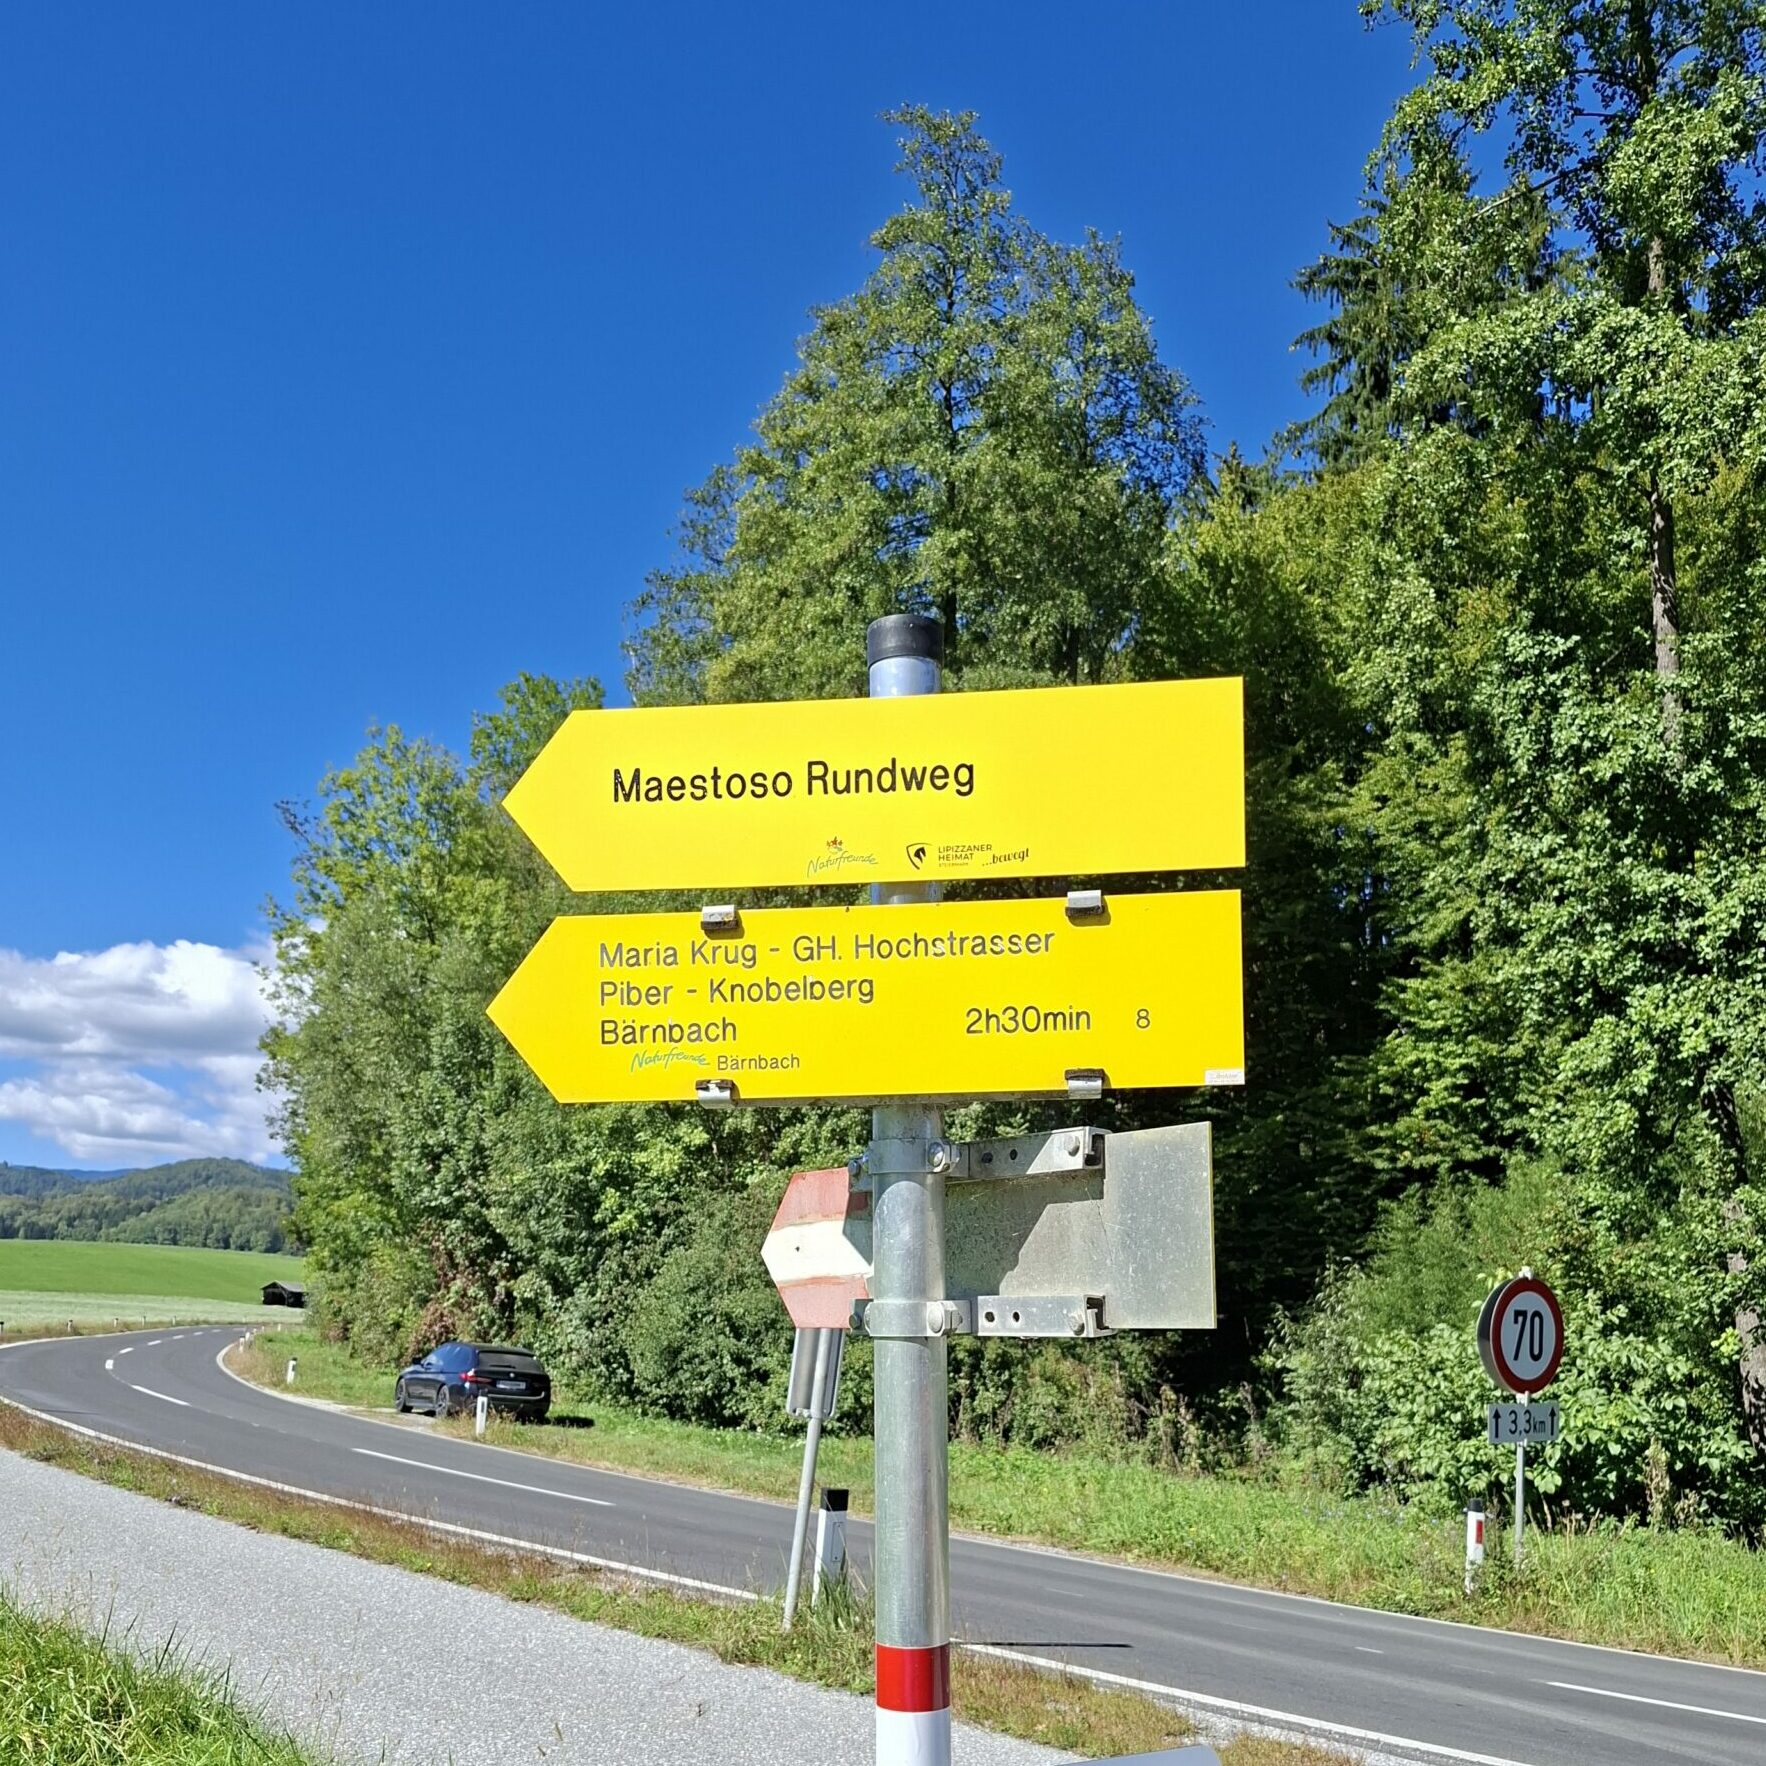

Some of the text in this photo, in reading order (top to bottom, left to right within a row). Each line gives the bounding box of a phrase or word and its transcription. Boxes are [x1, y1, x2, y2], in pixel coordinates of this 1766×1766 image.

[613, 757, 975, 803] Maestoso Rundweg
[938, 843, 993, 854] LIPIZZANER
[938, 853, 974, 862] HEIMAT
[806, 850, 879, 878] Naturfreunde
[600, 942, 679, 968] Maria
[691, 939, 757, 969] Krug
[793, 935, 843, 962] GH.
[854, 930, 1055, 960] Hochstrasser
[600, 980, 674, 1007] Piber
[709, 975, 874, 1007] Knobelberg
[600, 1016, 737, 1045] Bärnbach
[966, 1005, 1091, 1034] 2h30min
[1136, 1008, 1151, 1029] 8
[630, 1047, 800, 1073] Naturfreunde Bärnbach
[1513, 1309, 1544, 1362] 70
